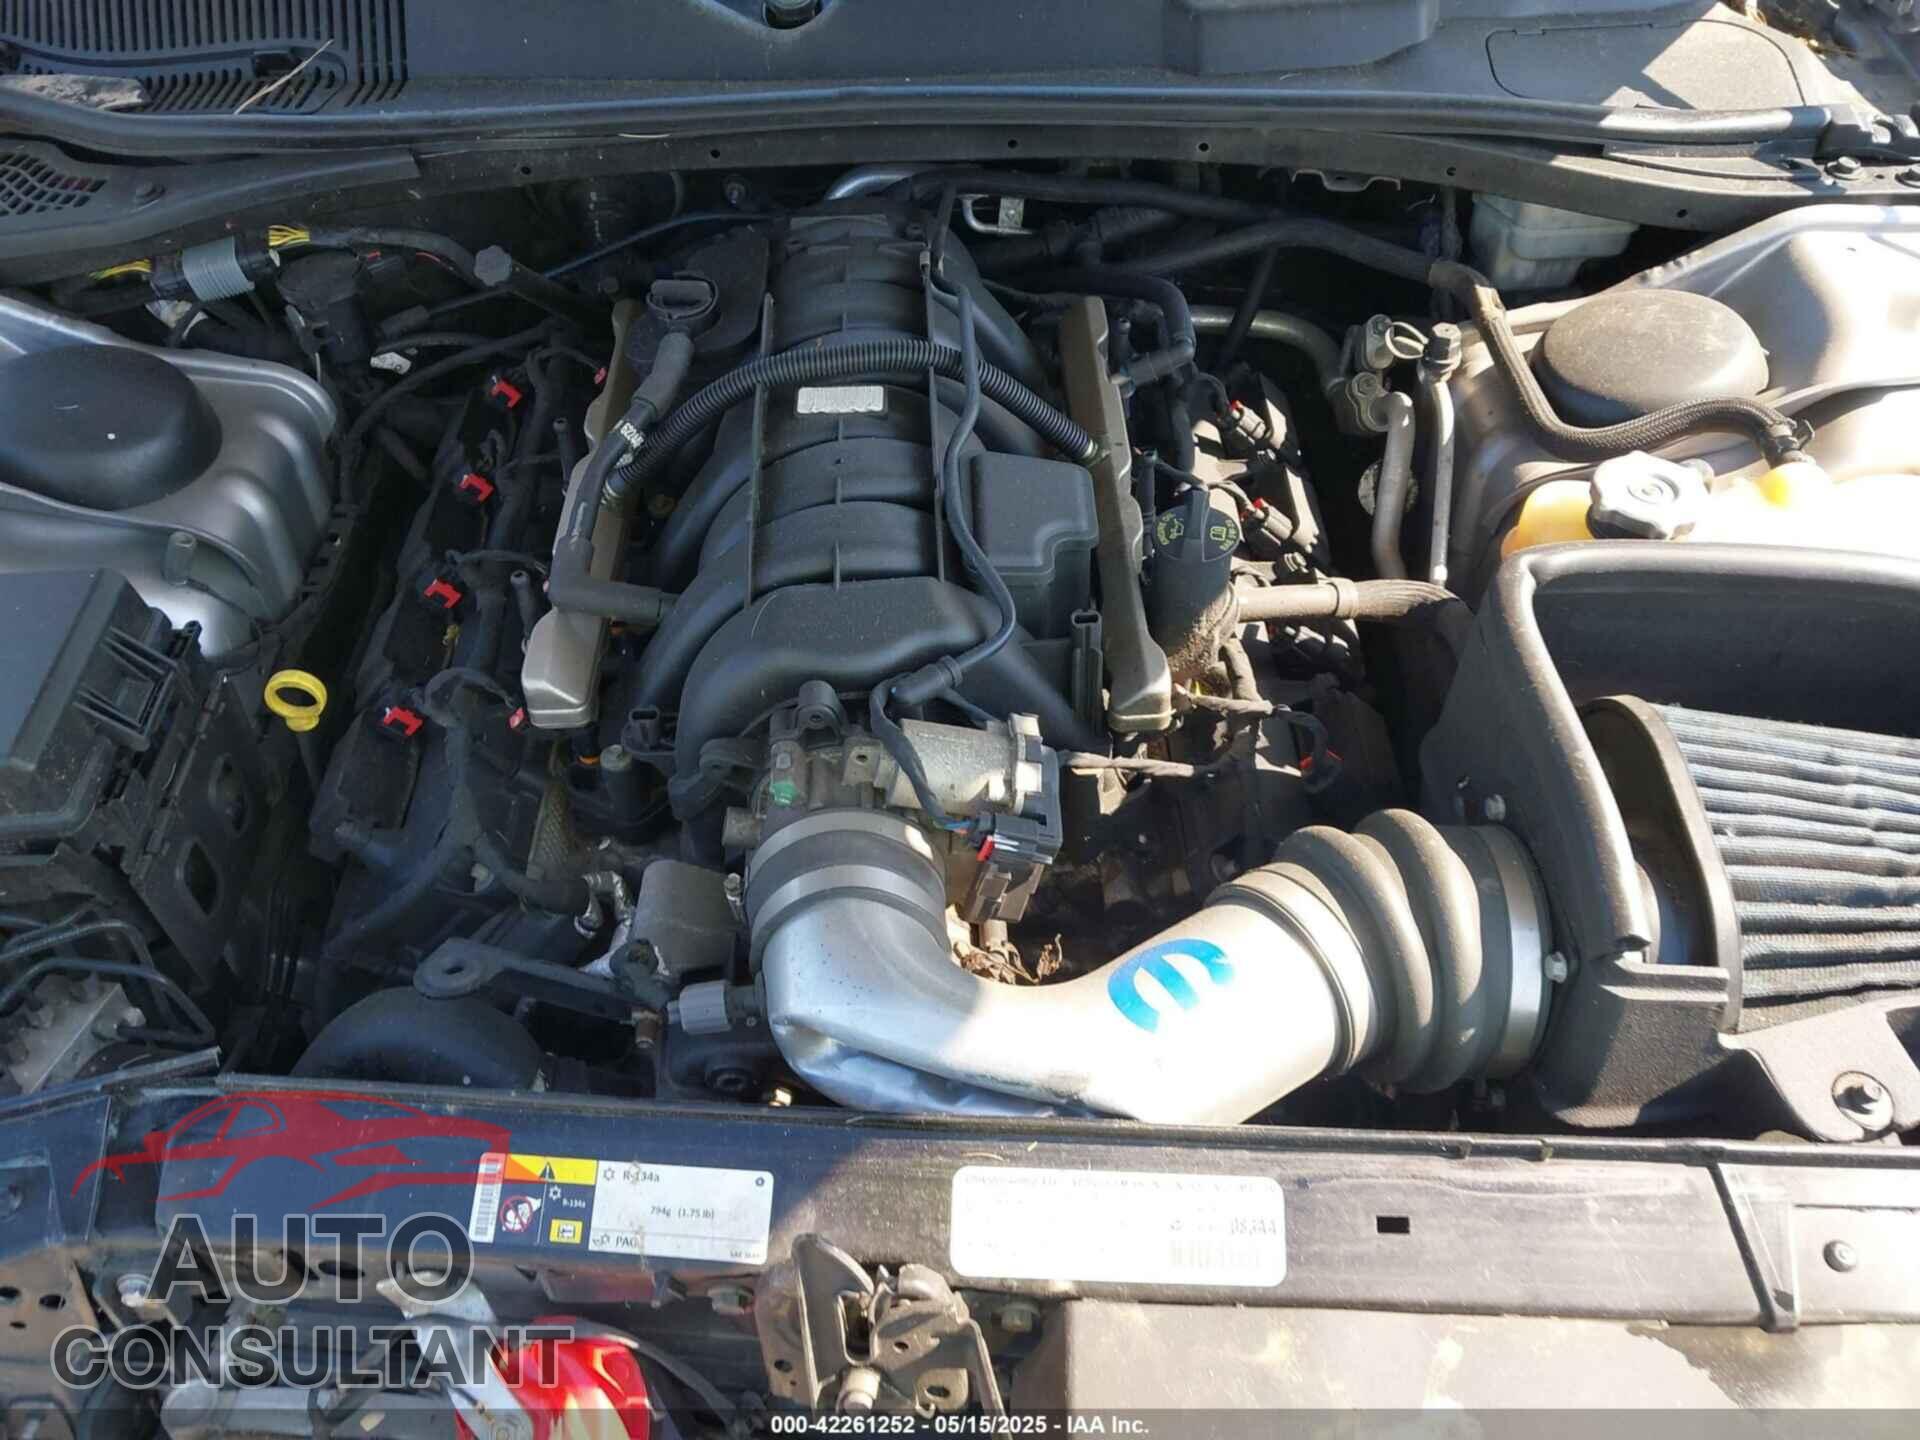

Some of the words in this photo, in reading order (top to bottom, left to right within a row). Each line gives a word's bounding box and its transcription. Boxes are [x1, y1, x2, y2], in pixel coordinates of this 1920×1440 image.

[623, 1170, 660, 1183] R-134a
[651, 1205, 672, 1218] 794g
[678, 1208, 701, 1220] (1.75
[702, 1210, 715, 1220] lb)
